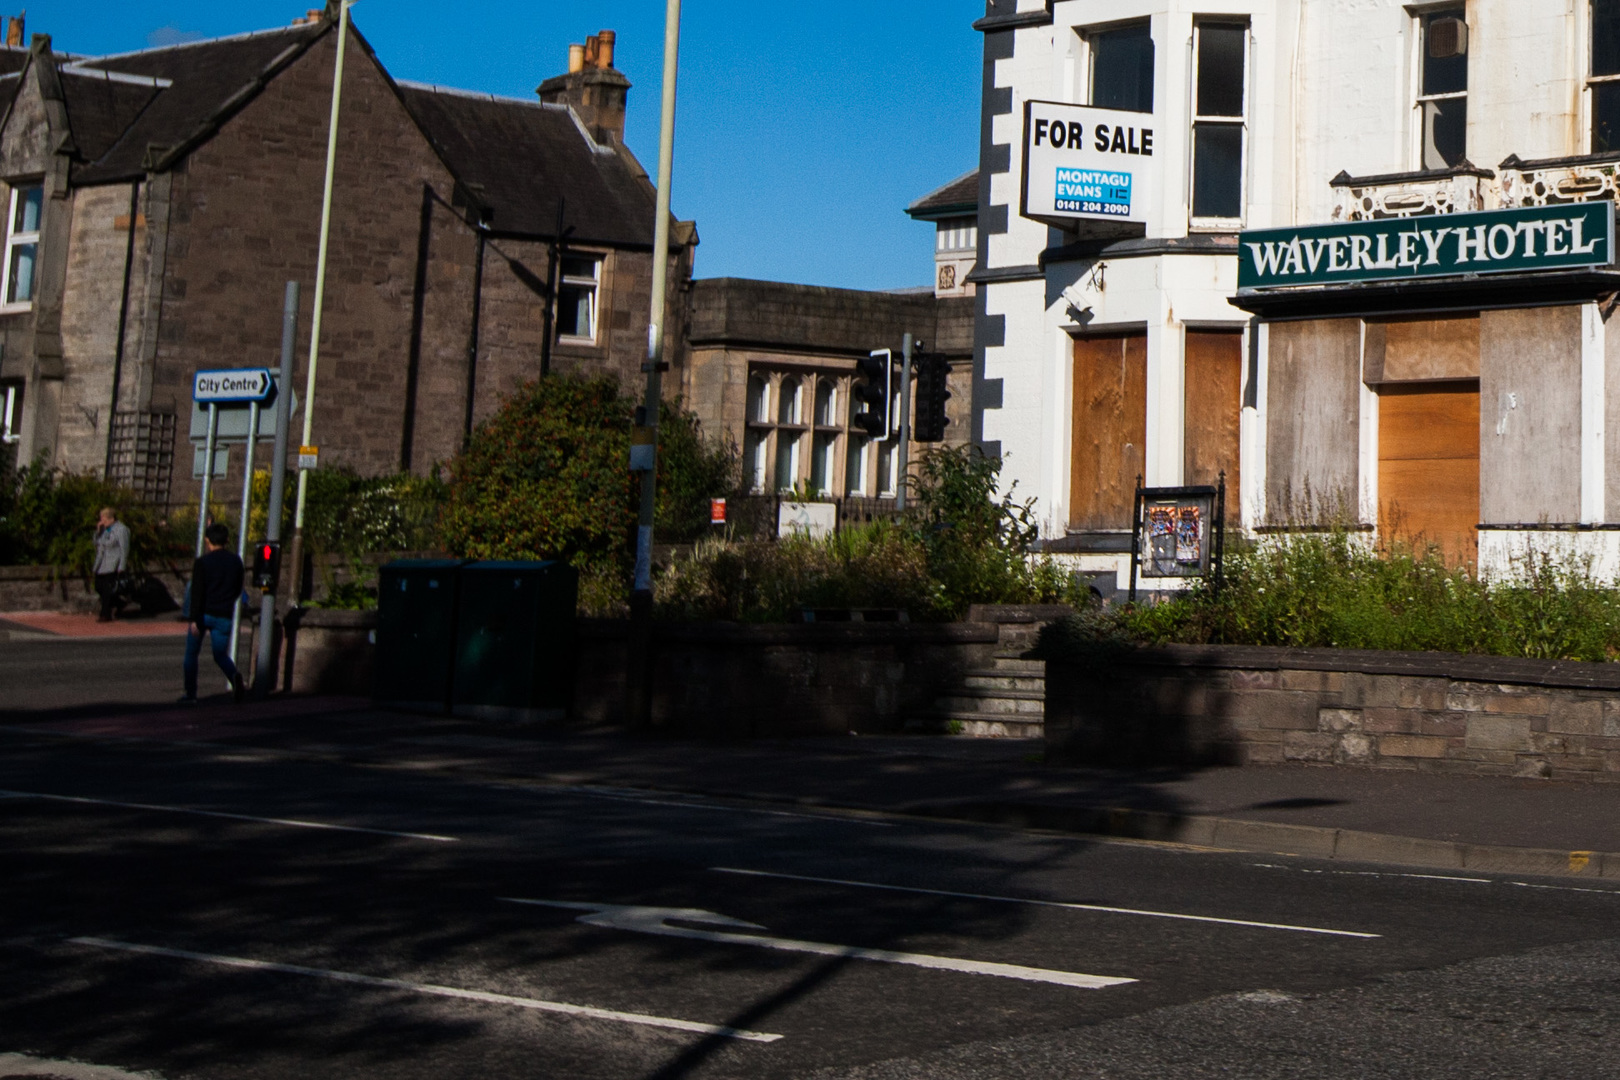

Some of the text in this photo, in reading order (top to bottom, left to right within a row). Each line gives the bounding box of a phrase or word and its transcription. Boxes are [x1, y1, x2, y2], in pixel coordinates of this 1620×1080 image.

[1034, 119, 1153, 156] FOR SALE
[1057, 170, 1129, 187] MONTAGU
[1057, 183, 1102, 198] EVANS
[1056, 199, 1129, 215] 0141 204 2090
[1242, 213, 1605, 277] WAVERLEY HOTEL
[198, 377, 258, 393] City Centre
